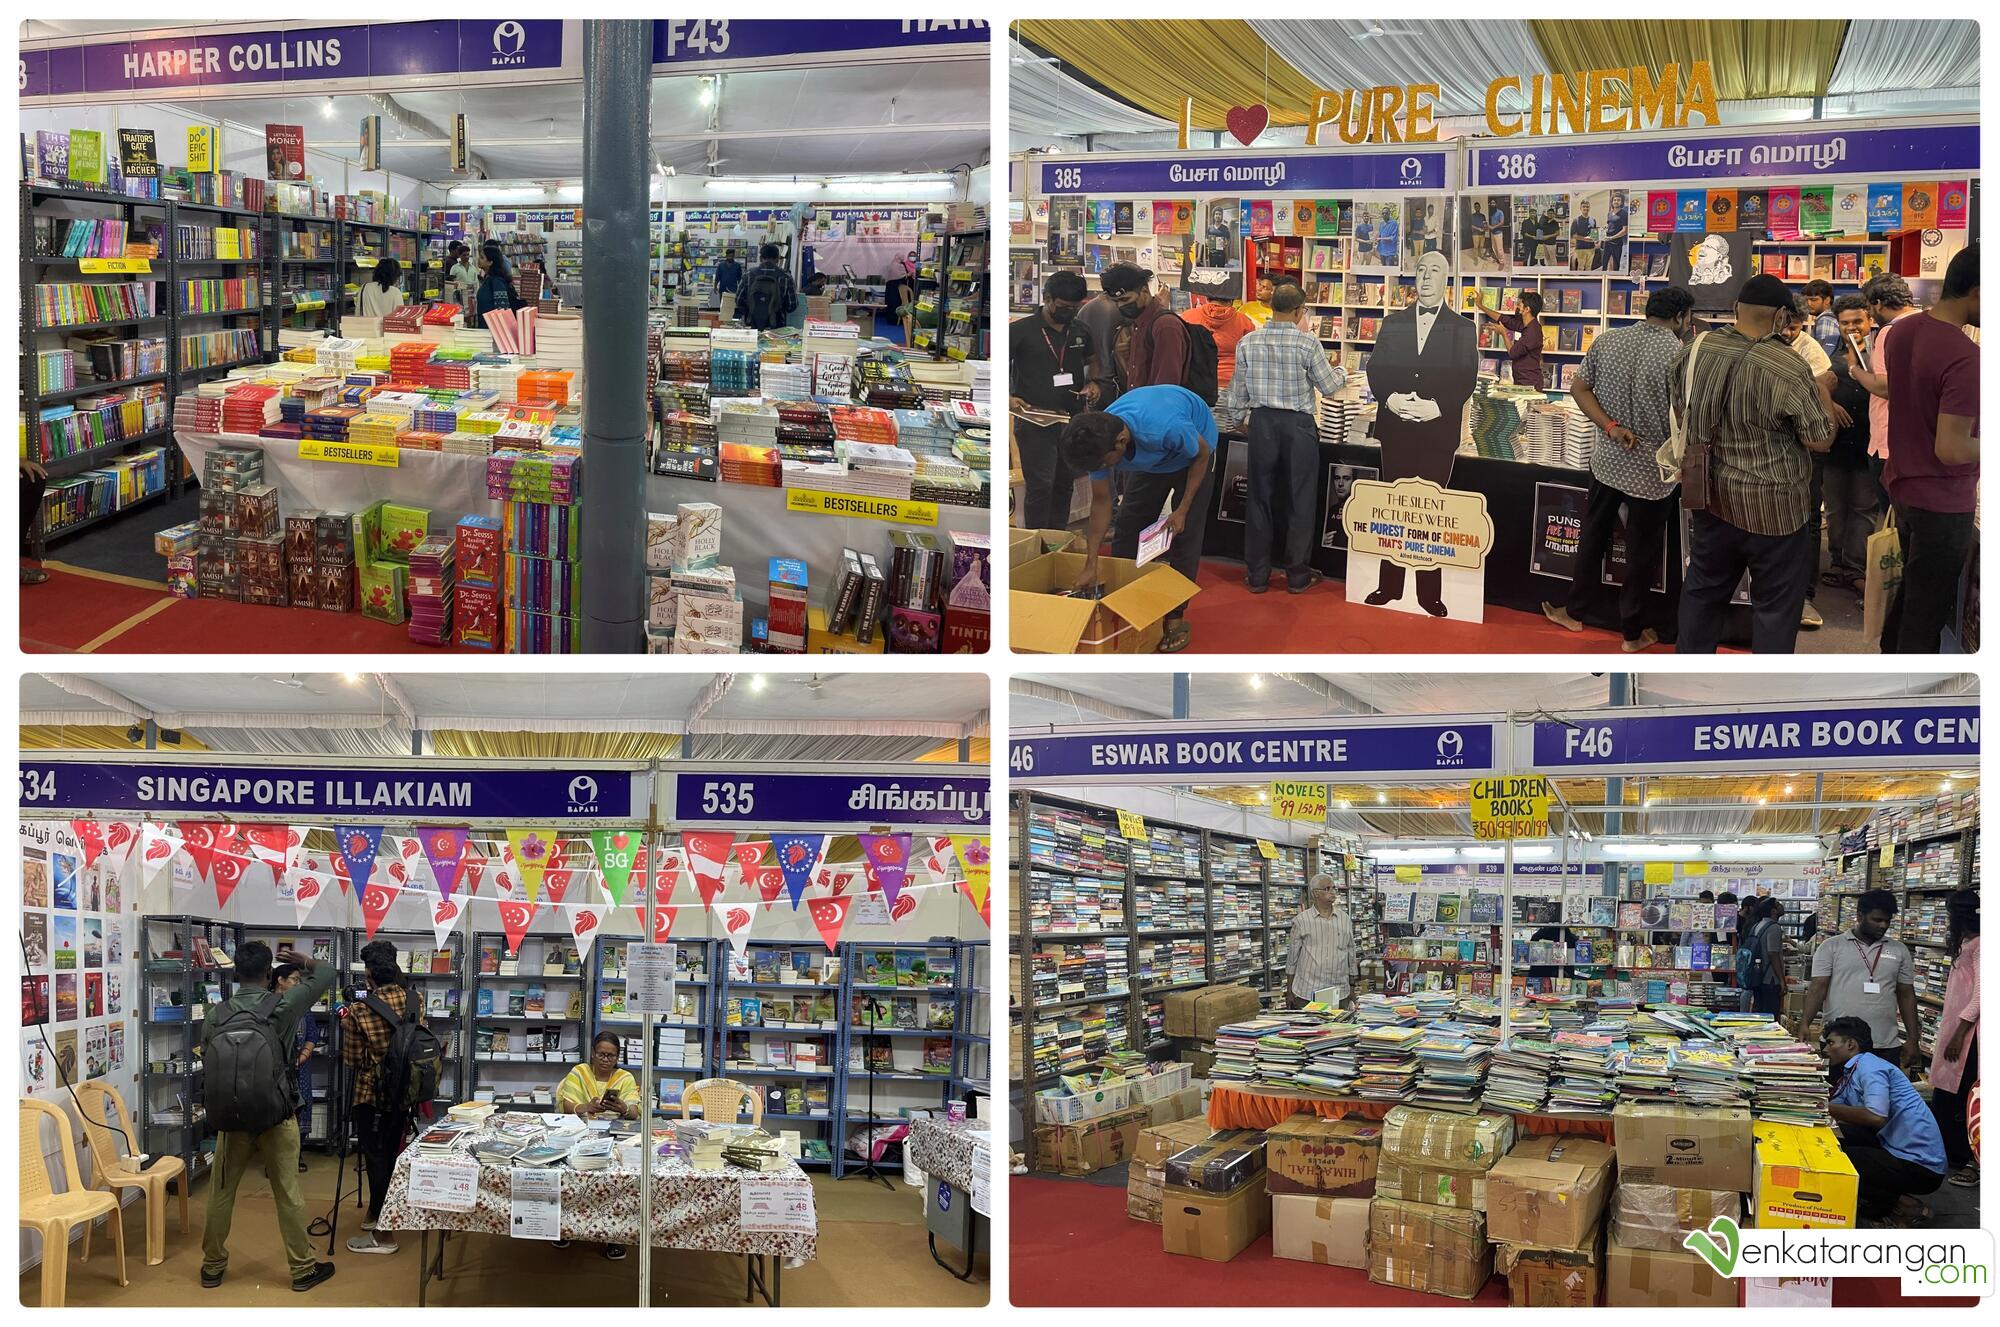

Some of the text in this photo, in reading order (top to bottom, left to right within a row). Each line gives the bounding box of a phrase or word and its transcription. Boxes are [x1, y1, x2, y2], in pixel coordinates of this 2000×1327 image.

[667, 19, 730, 57] F43
[123, 46, 221, 79] HARPER
[228, 38, 342, 72] COLLINS
[491, 56, 526, 65] BAPASI
[1176, 60, 1721, 149] I PURE CINEMA
[122, 133, 154, 143] TRAITORS
[189, 133, 201, 143] DO
[269, 137, 302, 145] MONEY
[131, 142, 147, 151] GATE
[189, 143, 206, 152] EPIC
[189, 153, 206, 162] SHIT
[1667, 136, 1848, 170] பேசா மொழி
[46, 166, 67, 175] NOW
[126, 166, 156, 175] ARCHER
[1497, 153, 1536, 180] 386
[1054, 167, 1082, 189] 385
[1169, 161, 1287, 187] பேசா மொழி
[495, 213, 507, 222] F69
[527, 213, 545, 222] OOKS
[107, 261, 127, 270] FICTION
[323, 446, 374, 462] BESTSELLERS
[239, 496, 259, 506] RAM
[1386, 493, 1447, 512] THE SILENT
[823, 496, 898, 517] BESTSELLERS
[1371, 507, 1460, 530] PICTURES WERE
[1547, 515, 1582, 528] PUNS
[289, 520, 311, 530] RAM
[202, 527, 223, 536] AMISH
[243, 531, 262, 540] AMISH
[462, 528, 473, 538] Dr.
[1353, 521, 1481, 549] THE PUREST FORM OF CINEMA
[1546, 525, 1581, 540] ARE THE
[463, 542, 479, 550] Ladder
[467, 537, 486, 546] Reading
[694, 537, 716, 546] HOLLY
[694, 544, 716, 552] BLACK
[1377, 537, 1456, 557] THAT'S PURE CINEMA
[290, 555, 312, 564] AMISH
[320, 556, 343, 565] AMISH
[293, 564, 313, 575] RAM
[321, 566, 342, 577] RAM
[202, 572, 224, 581] AMISH
[460, 590, 471, 599] Dr.
[293, 599, 314, 608] AMISH
[321, 603, 343, 612] AMISH
[461, 603, 477, 611] Ladder
[1564, 717, 1980, 760] F46 ESWAR BOOK CEN
[1009, 738, 1348, 772] 46 ESWAR BOOK CENTRE
[1436, 758, 1464, 766] BAPASI
[136, 776, 315, 805] SINGAPORE
[324, 782, 472, 808] ILLAKIAM
[1275, 782, 1326, 799] NOVELS
[1473, 778, 1547, 800] CHILDREN
[702, 782, 755, 815] 535
[567, 805, 598, 813] BAPASI
[1281, 800, 1295, 817] 99
[1490, 799, 1534, 817] BOOKS
[604, 853, 629, 869] SG
[1485, 865, 1497, 873] 539
[1802, 867, 1821, 876] 540
[1288, 1164, 1358, 1179] HIMAHAL
[459, 1182, 470, 1192] 48
[796, 1202, 807, 1212] 48
[1782, 1201, 1806, 1210] Produce
